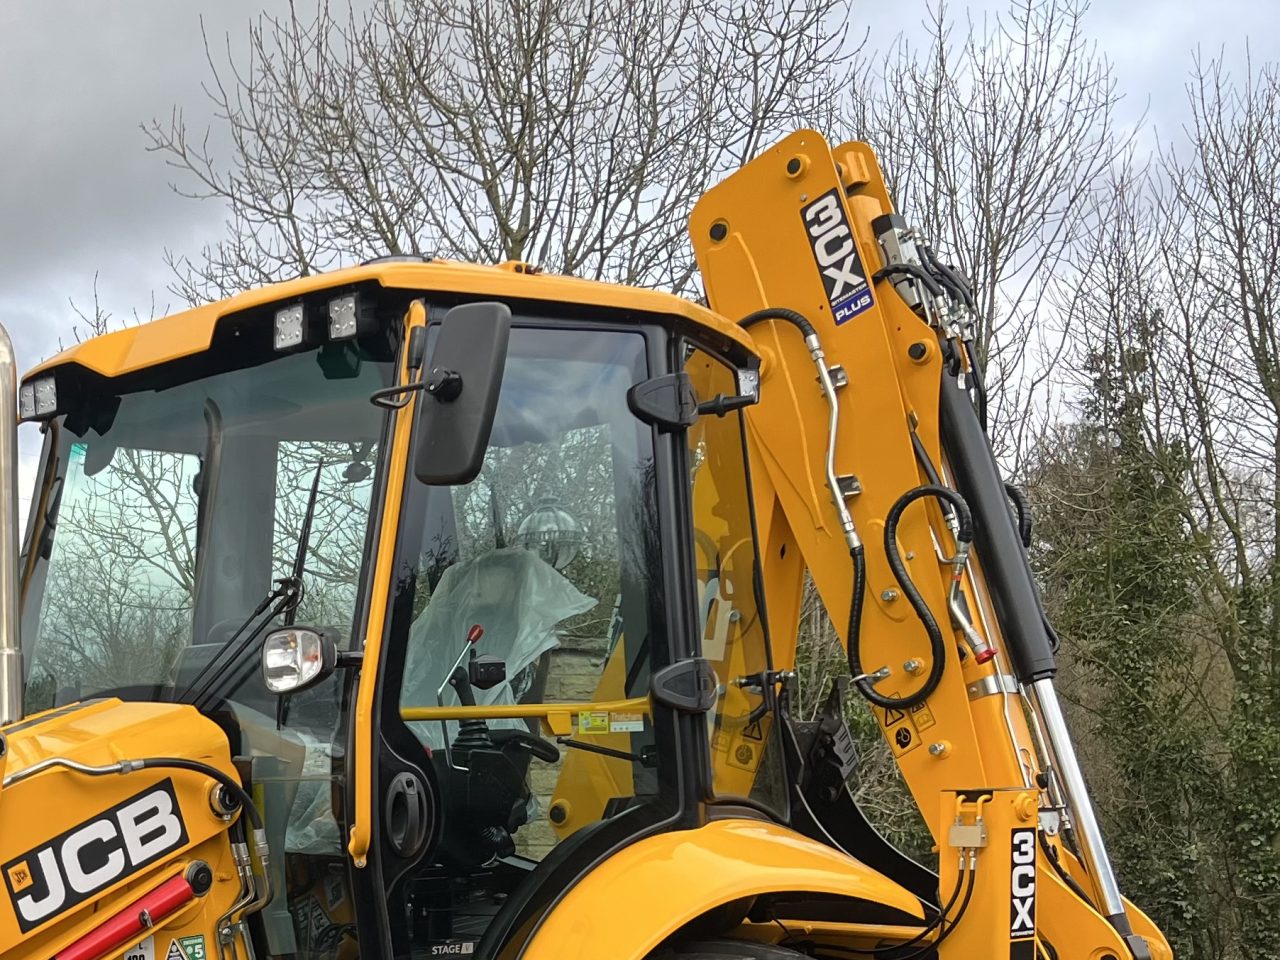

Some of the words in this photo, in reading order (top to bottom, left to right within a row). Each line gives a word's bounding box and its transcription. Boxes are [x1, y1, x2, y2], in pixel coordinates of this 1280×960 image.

[805, 194, 865, 300] 3CX
[835, 294, 871, 321] PLUS
[17, 789, 182, 922] JCB
[1011, 831, 1035, 930] 3CX
[194, 944, 204, 958] 5
[432, 944, 461, 955] STAGE
